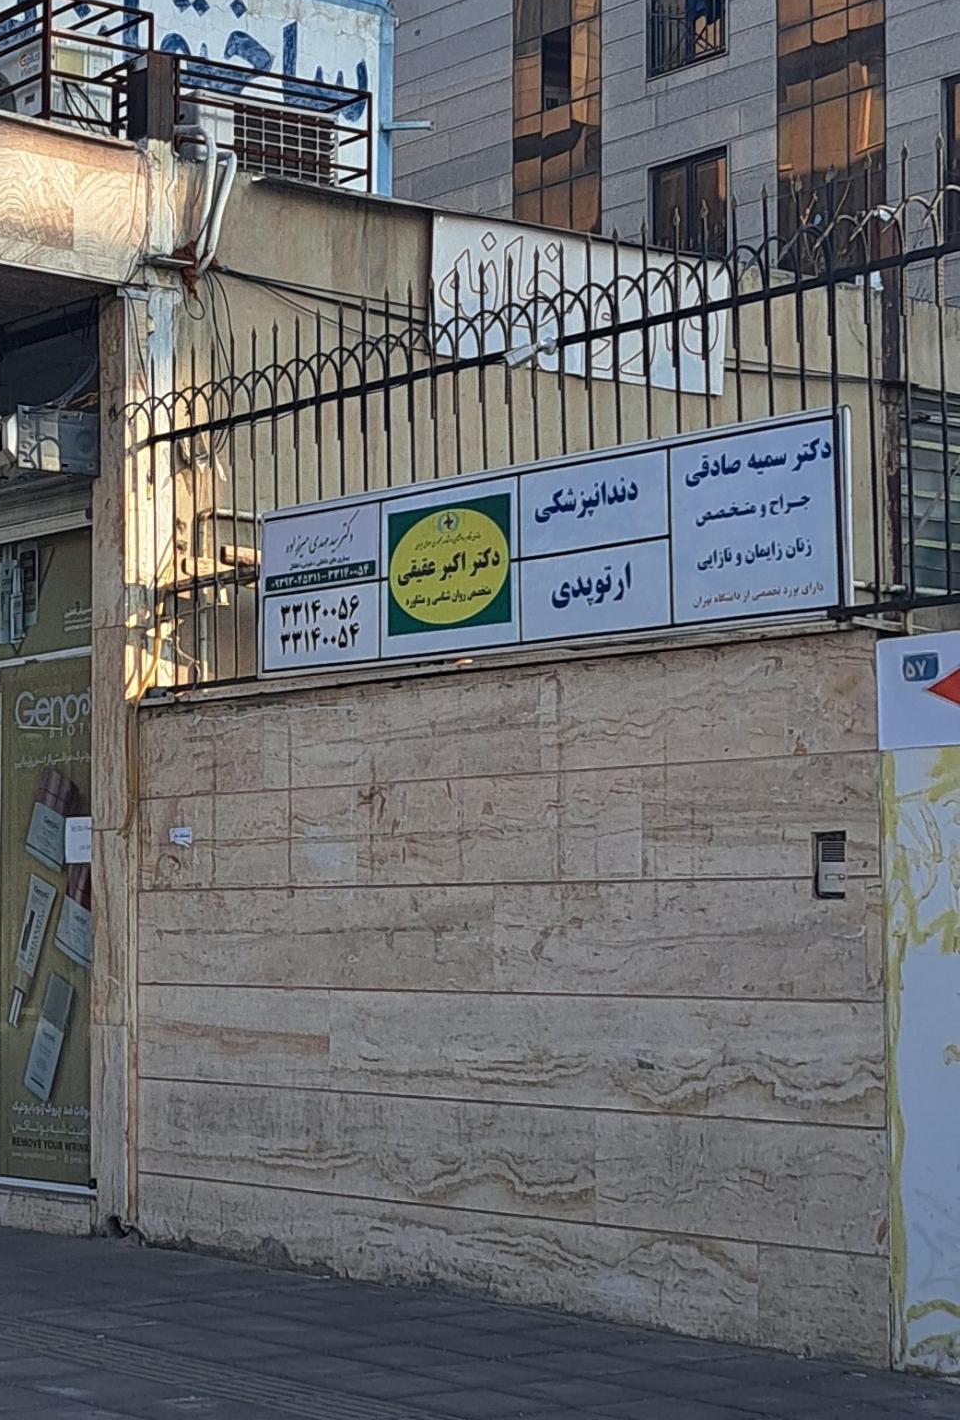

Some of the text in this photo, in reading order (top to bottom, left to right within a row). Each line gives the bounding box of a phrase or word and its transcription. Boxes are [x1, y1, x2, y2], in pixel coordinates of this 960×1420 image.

[685, 435, 832, 488] دکتر سمیه صادقی
[534, 475, 638, 523] دندانپزشکی
[695, 494, 811, 527] جراح و متخصص
[336, 509, 361, 549] دکتر
[397, 547, 501, 588] دکتر اکبر عقیقی
[696, 536, 812, 571] زنان زایمان و نازایی
[467, 586, 492, 602] متخصص
[551, 560, 631, 608] ارتوپدی
[280, 594, 360, 628] ۳۳۱۴۰۰۵۶
[280, 622, 360, 655] ۳۳۱۴۰۰۵۴
[905, 659, 927, 679] ۵۷
[64, 1139, 90, 1153] WRINK
